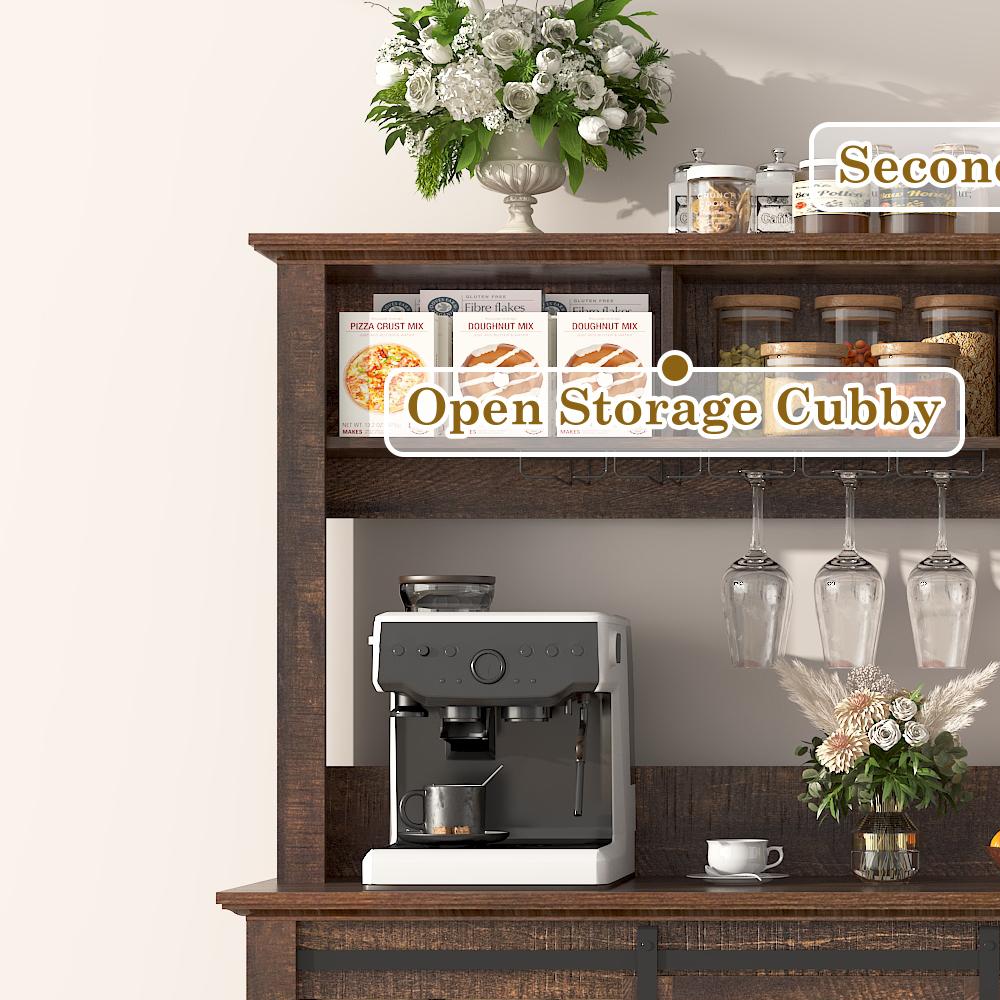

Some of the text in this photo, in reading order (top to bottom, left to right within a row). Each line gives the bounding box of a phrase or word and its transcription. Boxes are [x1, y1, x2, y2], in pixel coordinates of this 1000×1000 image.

[465, 302, 526, 312] Fibre flakes
[350, 322, 424, 330] PIZZA CRUST MIX
[468, 322, 534, 330] DOUGHNUT MIX
[572, 322, 638, 330] DOUGHNUT MIX
